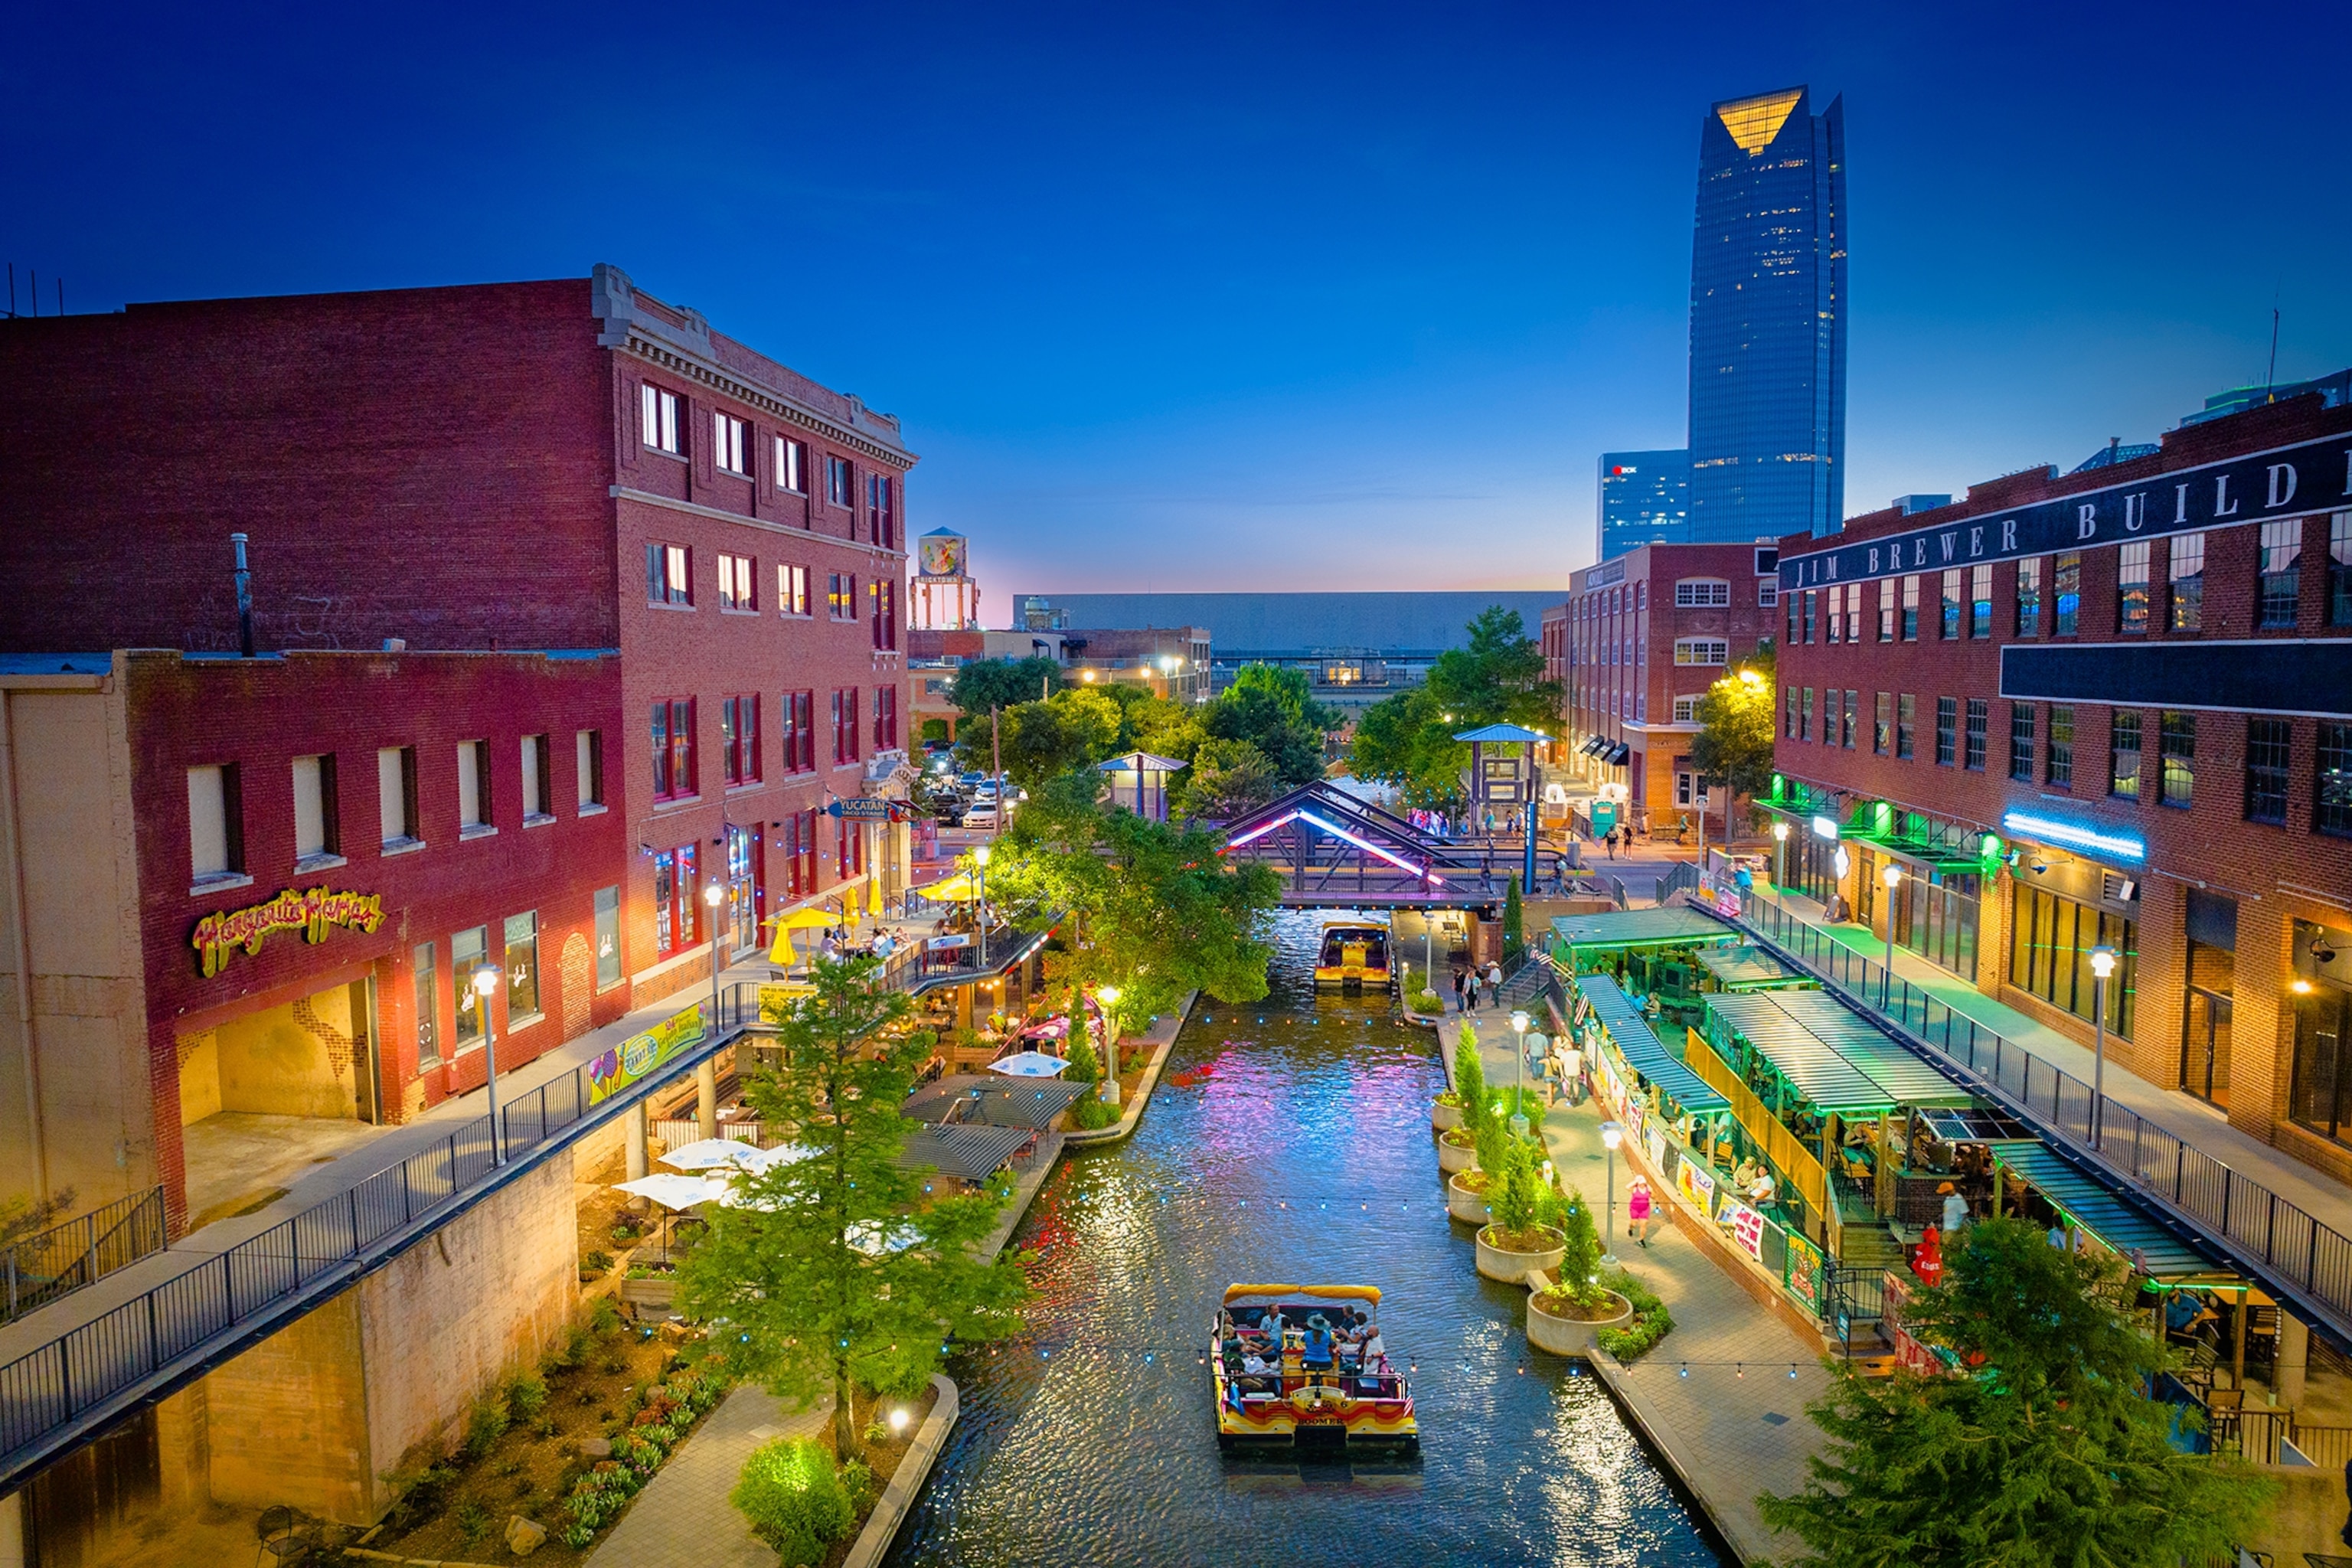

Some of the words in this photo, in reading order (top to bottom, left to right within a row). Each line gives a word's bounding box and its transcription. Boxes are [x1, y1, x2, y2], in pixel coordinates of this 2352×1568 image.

[1796, 555, 1838, 587] JIM
[1868, 519, 2017, 573] BREWER
[840, 801, 885, 811] YUCATAN
